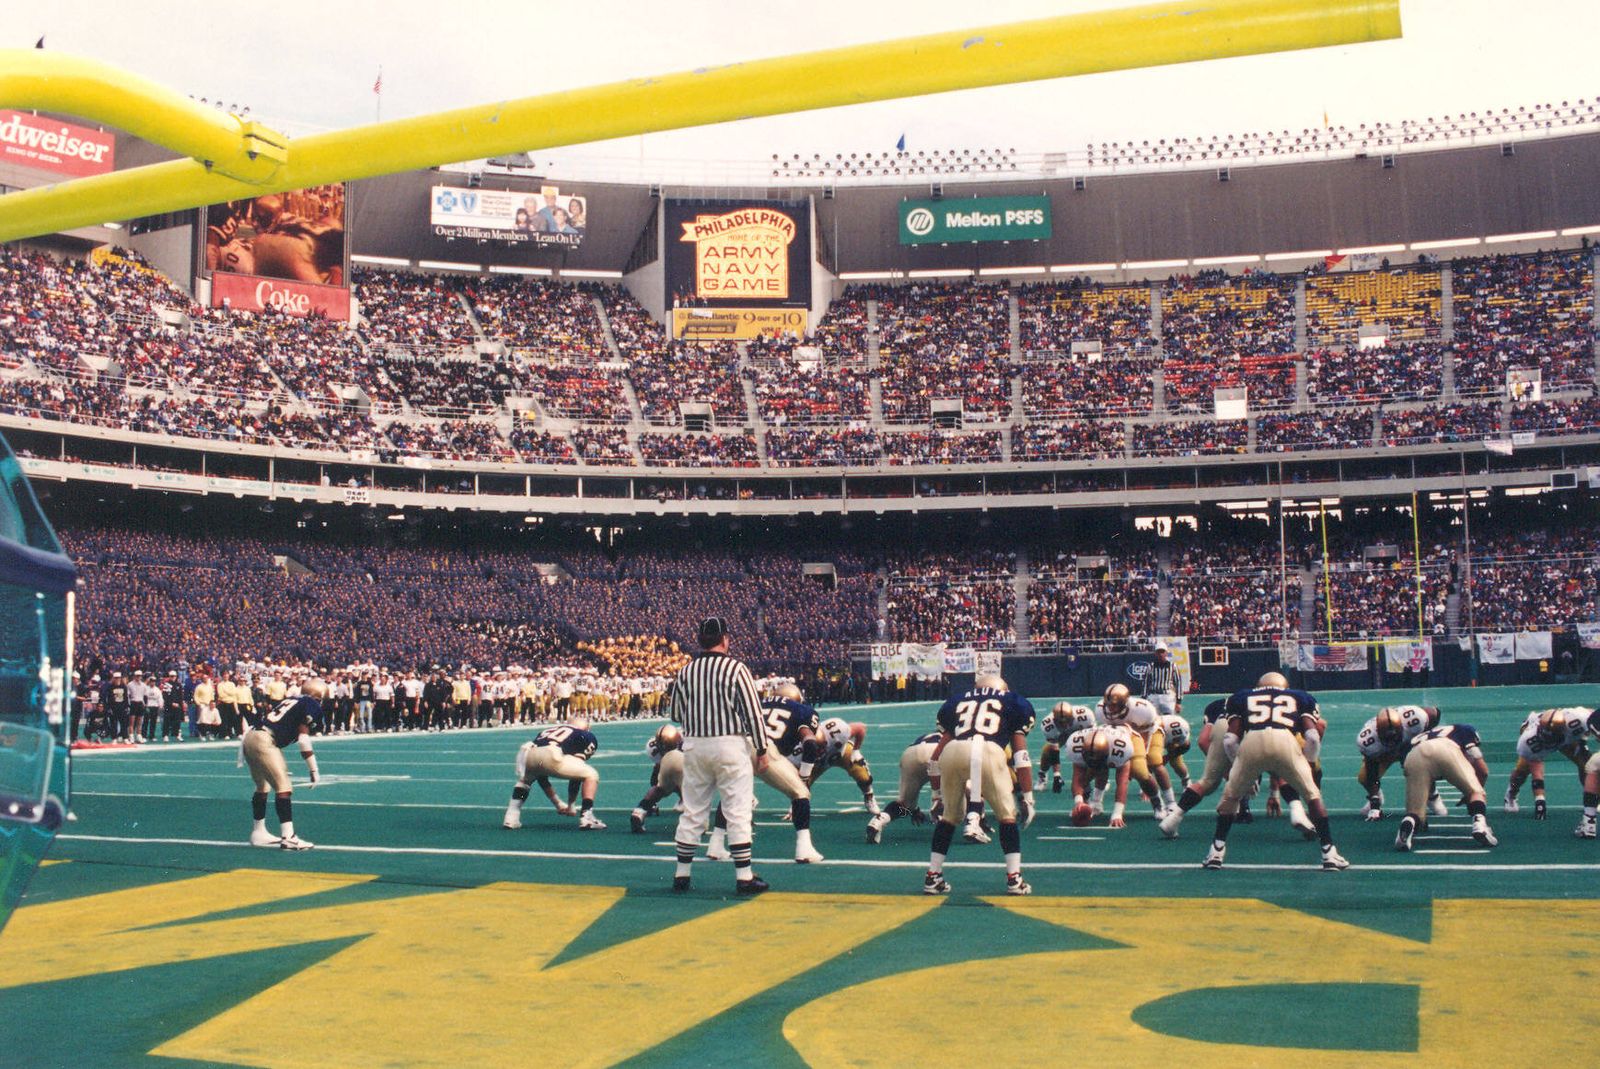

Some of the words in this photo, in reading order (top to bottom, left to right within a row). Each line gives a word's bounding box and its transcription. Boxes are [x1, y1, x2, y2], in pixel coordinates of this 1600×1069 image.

[0, 115, 110, 163] dweiser
[694, 212, 793, 238] PHILADELPHIA
[946, 212, 1001, 228] Mellon
[1005, 210, 1044, 226] PSFS
[435, 225, 456, 237] Over
[456, 227, 462, 237] 2
[463, 228, 492, 240] Million
[492, 230, 528, 242] Members
[556, 234, 570, 244] On
[704, 246, 780, 260] ARMY
[703, 262, 780, 275] NAVY
[703, 278, 780, 290] GAME
[255, 280, 310, 314] Coke
[743, 312, 756, 325] 9
[782, 312, 802, 326] 10
[954, 698, 1002, 737] 36
[1247, 694, 1297, 727] 52
[1112, 739, 1126, 758] 50
